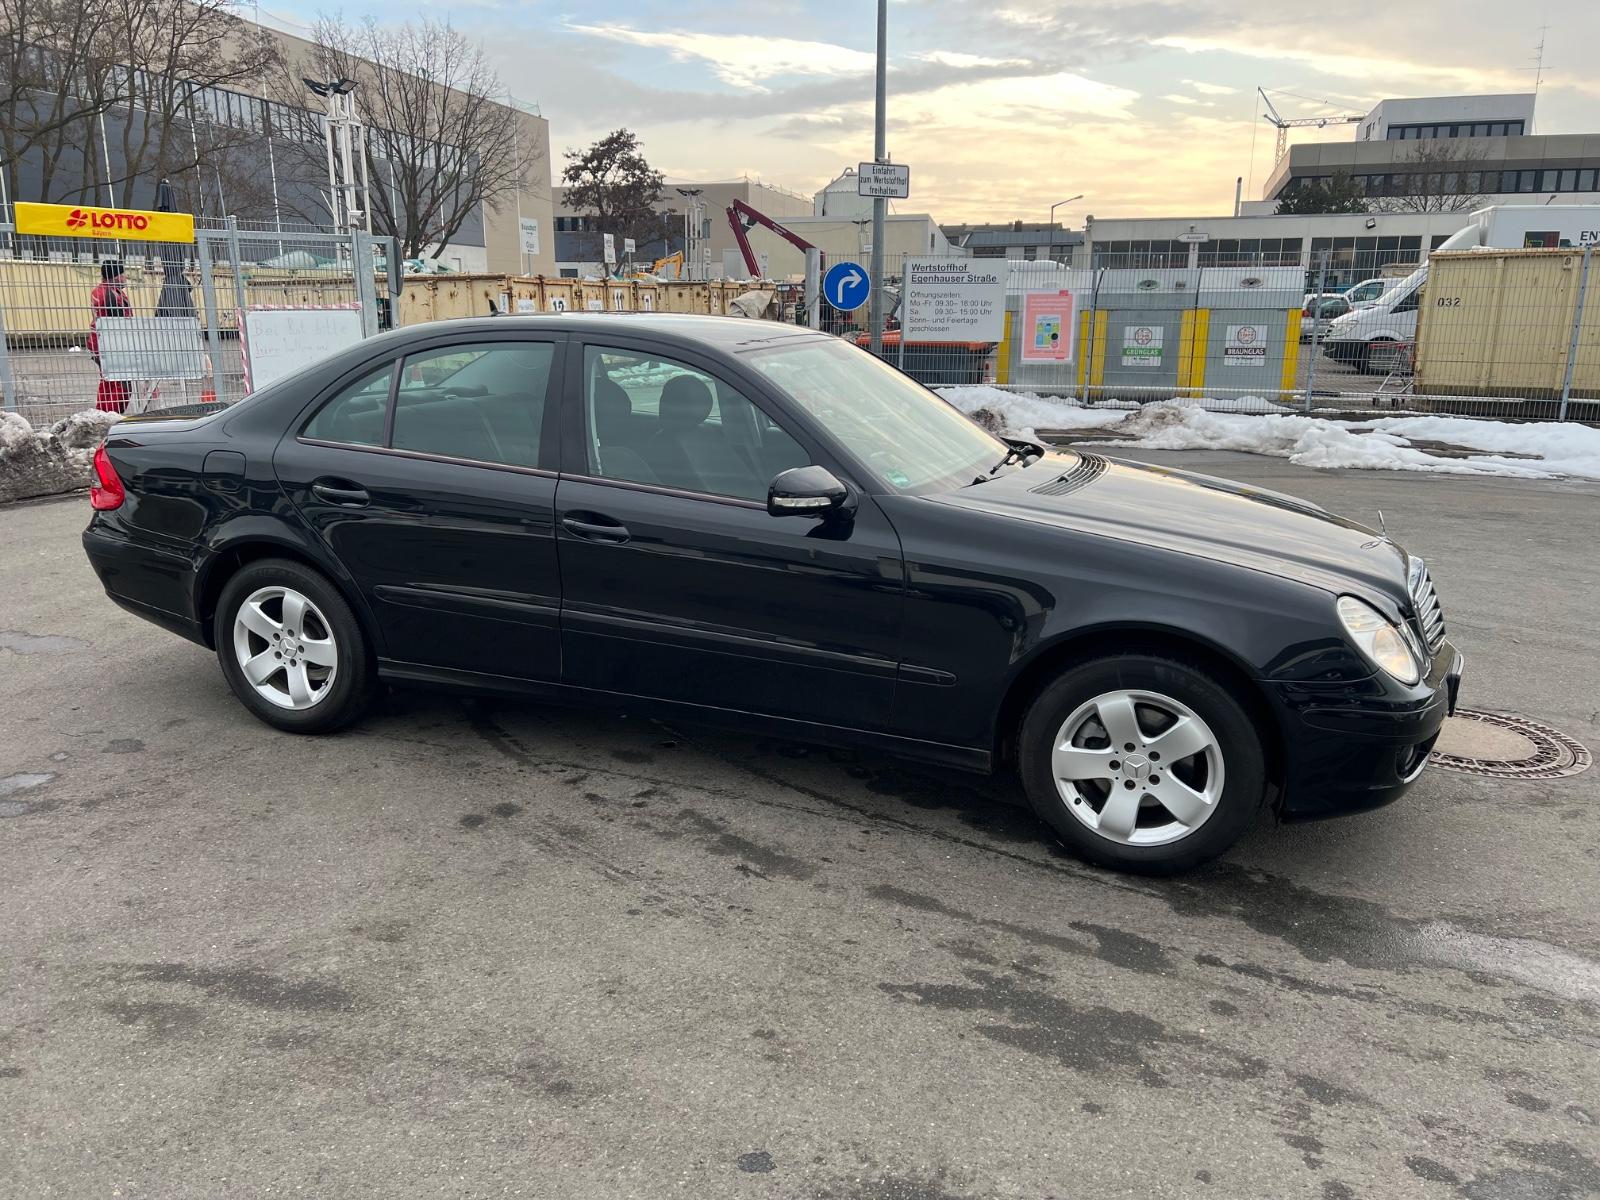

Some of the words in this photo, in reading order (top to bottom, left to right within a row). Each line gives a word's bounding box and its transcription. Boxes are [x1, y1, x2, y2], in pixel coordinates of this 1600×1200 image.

[872, 166, 896, 175] Einfahrt
[860, 176, 872, 184] zum
[869, 186, 898, 195] freihalten
[91, 212, 148, 230] LOTTO
[1579, 230, 1600, 242] EN
[911, 263, 968, 272] Wertstoffhof
[911, 274, 965, 284] Egenhauser
[967, 274, 997, 283] Straße
[1437, 297, 1461, 308] 032
[946, 317, 978, 326] Feiertage
